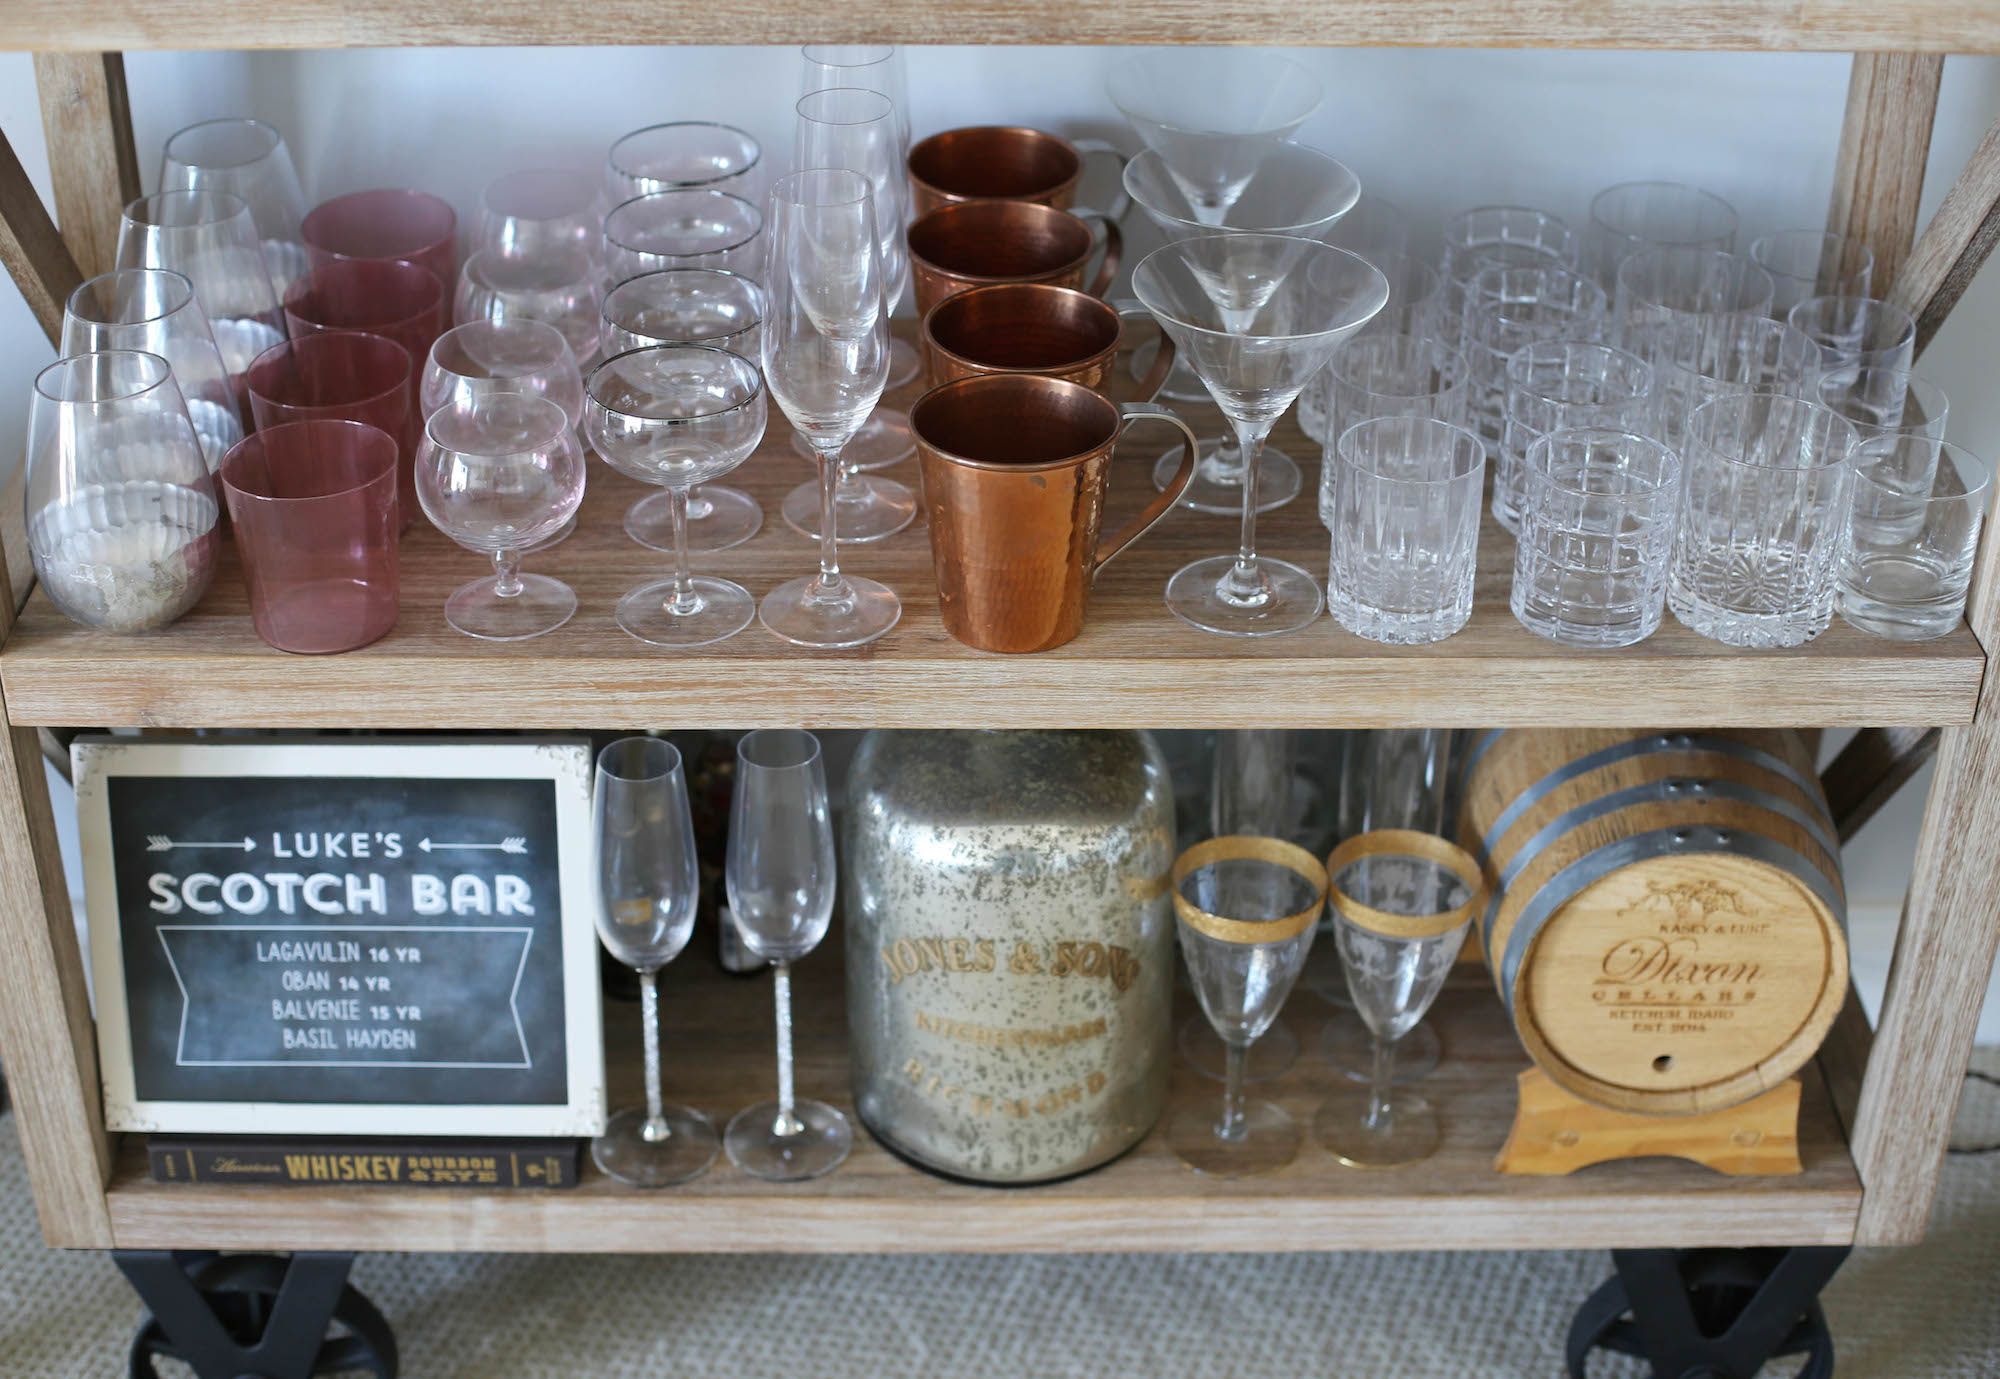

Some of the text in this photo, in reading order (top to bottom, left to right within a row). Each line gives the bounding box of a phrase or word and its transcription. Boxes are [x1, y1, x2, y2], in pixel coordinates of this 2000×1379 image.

[272, 832, 403, 859] LUKE'S
[147, 872, 536, 916] SCOTCH BAR
[256, 940, 422, 963] LAGAVULIN 16 YR
[881, 936, 996, 985] JONES
[1008, 942, 1041, 974] &
[1592, 935, 1766, 986] Dixon
[281, 969, 392, 992] OBAN 14 YR
[271, 998, 422, 1021] BALVENIE 15 YR
[283, 1027, 417, 1050] BASIL HAYDEN
[285, 1154, 401, 1181] WHISKEY
[407, 1156, 497, 1170] BOURBON
